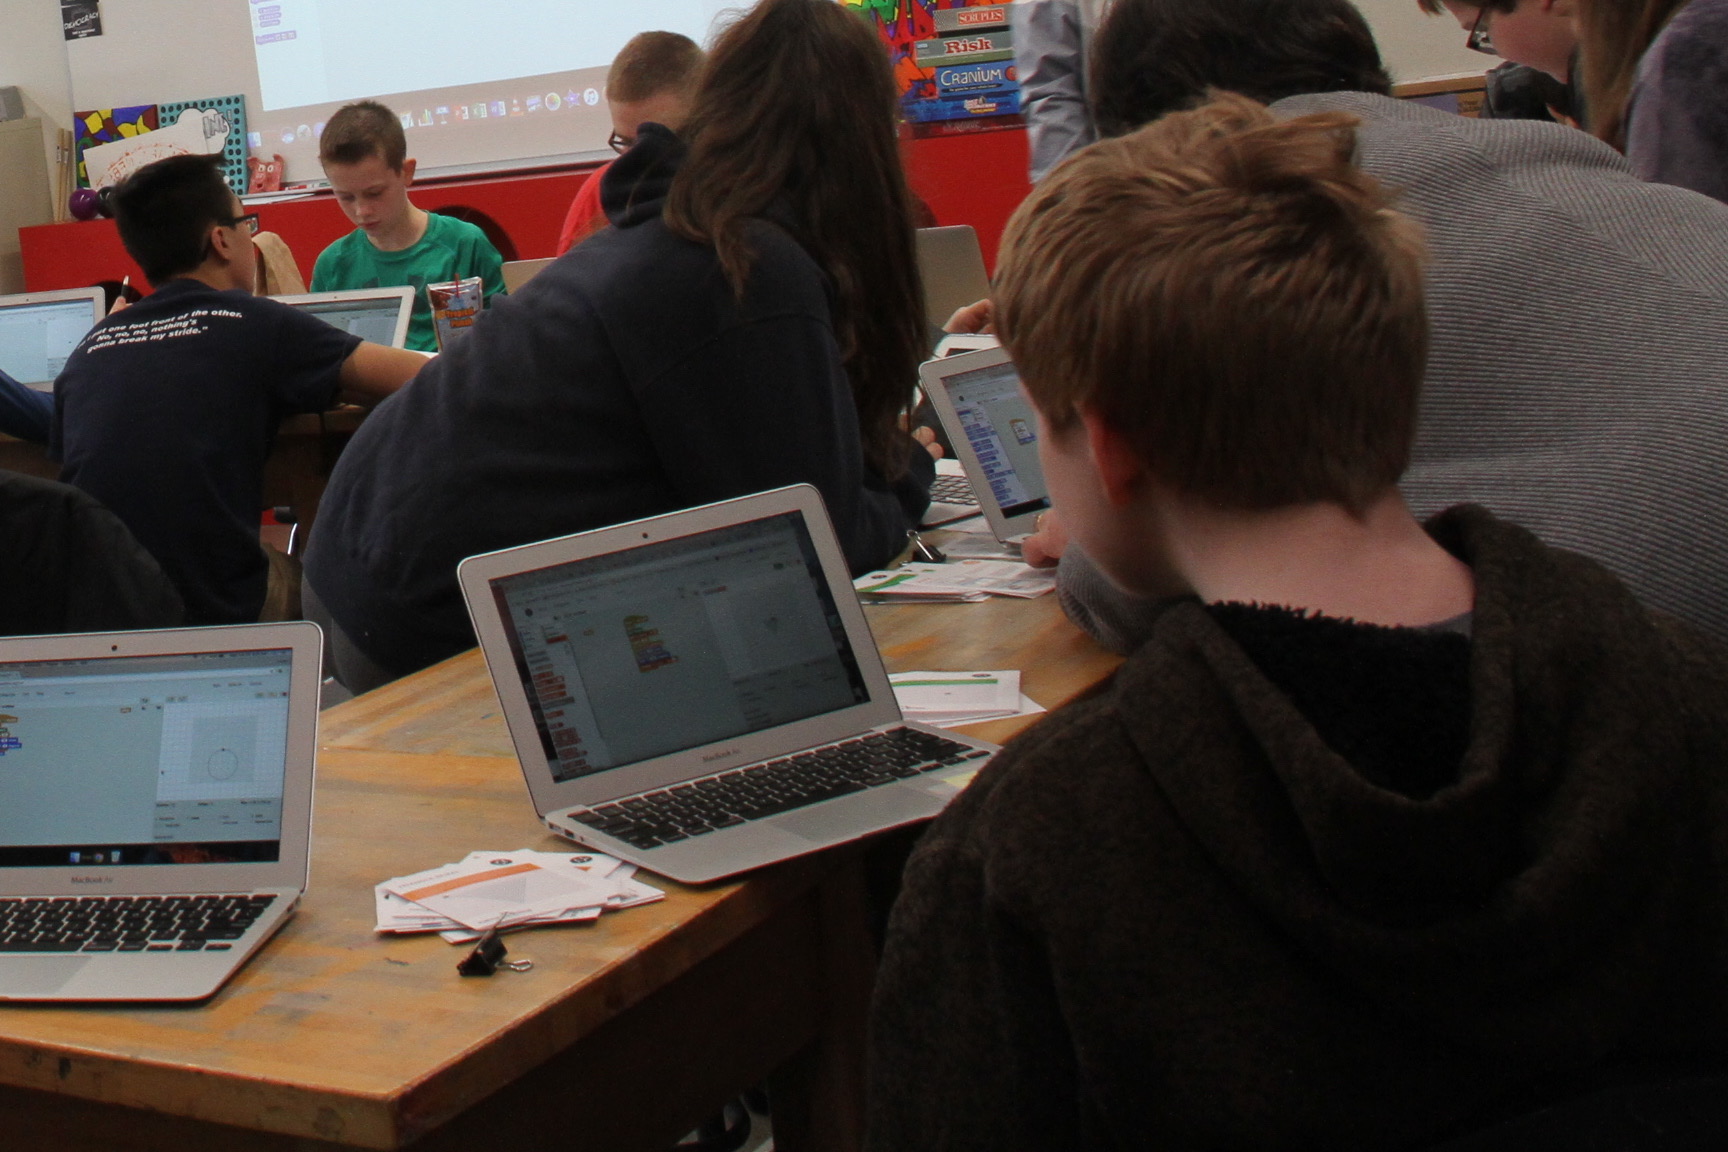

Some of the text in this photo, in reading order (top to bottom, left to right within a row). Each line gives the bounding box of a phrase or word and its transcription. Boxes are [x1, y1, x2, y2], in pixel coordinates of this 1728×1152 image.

[958, 9, 1003, 23] SCRUPLES
[944, 38, 992, 55] Risk
[129, 321, 149, 330] foot
[151, 317, 176, 327] front
[177, 313, 189, 322] of
[191, 309, 208, 318] the
[211, 310, 243, 318] other.
[97, 318, 197, 343] No, no, no, nothing's
[87, 340, 116, 354] gonna
[118, 334, 147, 346] break
[150, 333, 166, 341] my
[71, 875, 102, 884] MacBook
